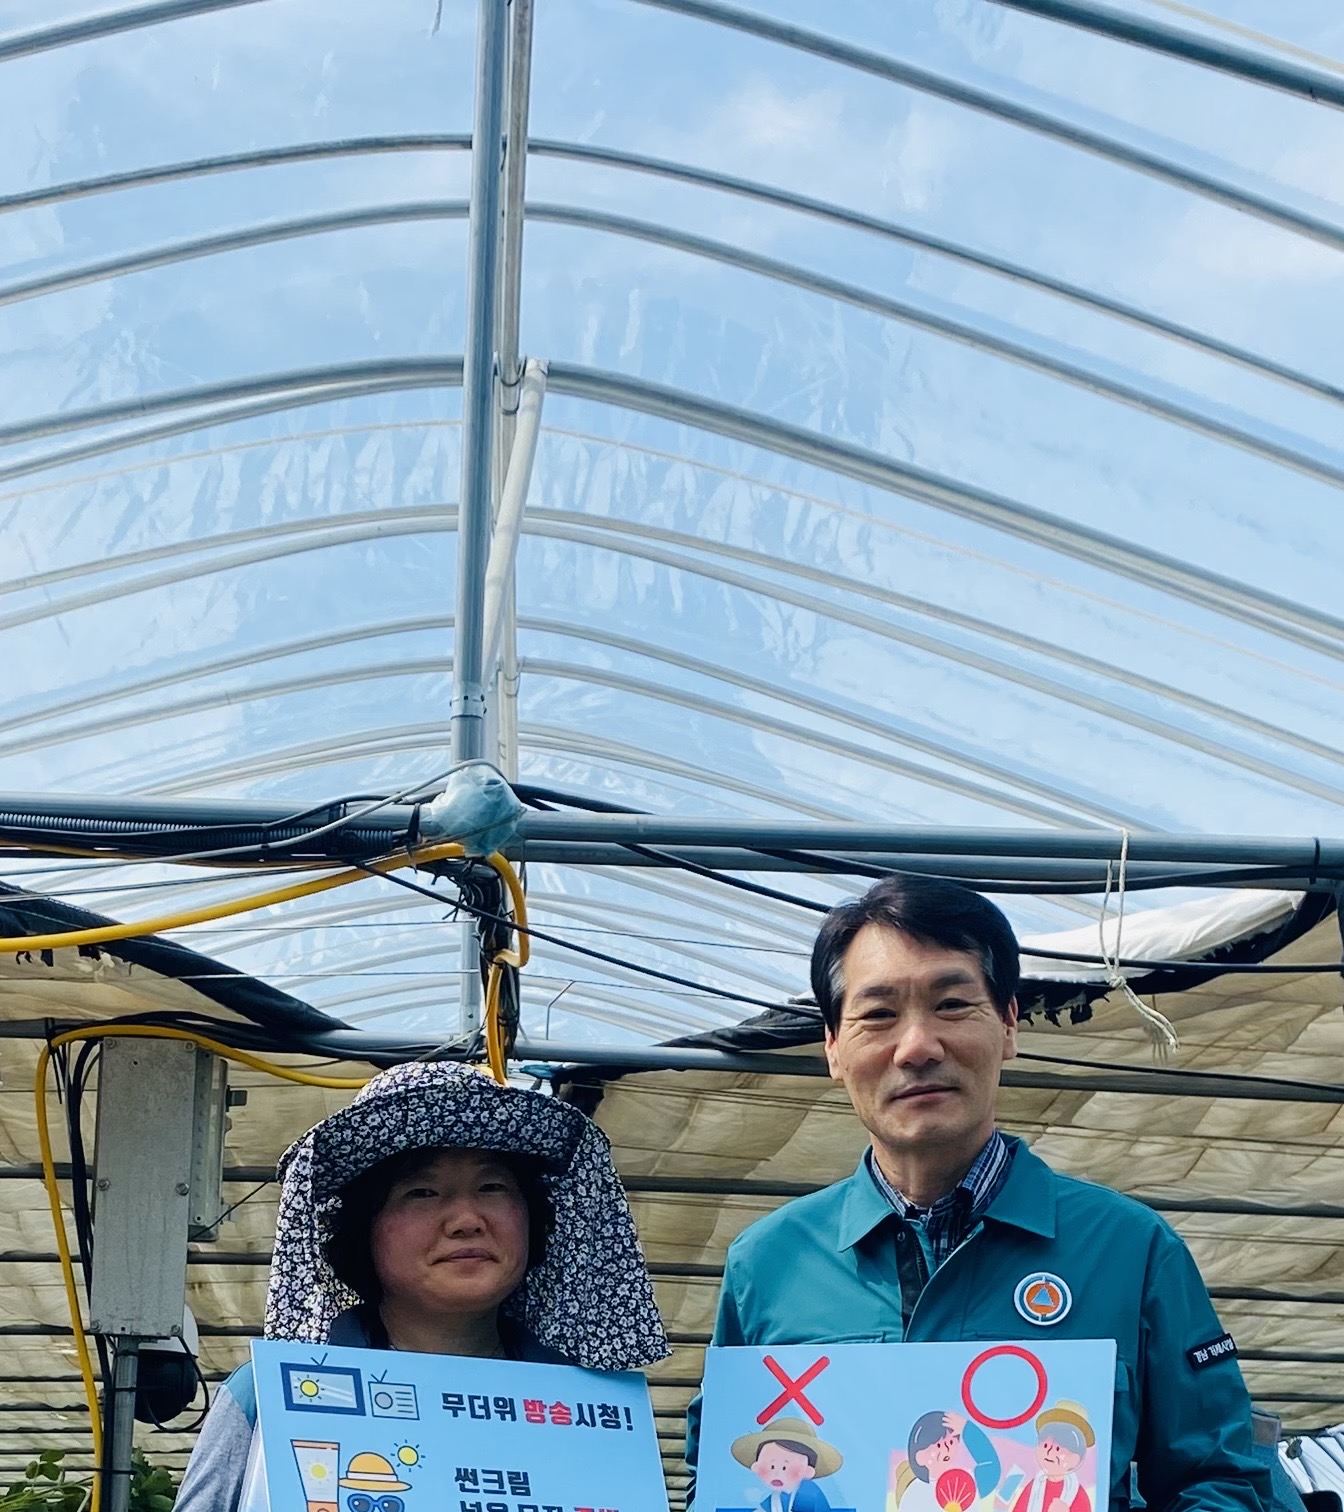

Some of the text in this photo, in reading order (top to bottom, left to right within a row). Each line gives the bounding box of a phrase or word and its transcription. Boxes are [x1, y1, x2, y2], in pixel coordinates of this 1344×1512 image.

[442, 1392, 634, 1432] 무더위 방송시청!
[454, 1466, 532, 1497] 썬크림
